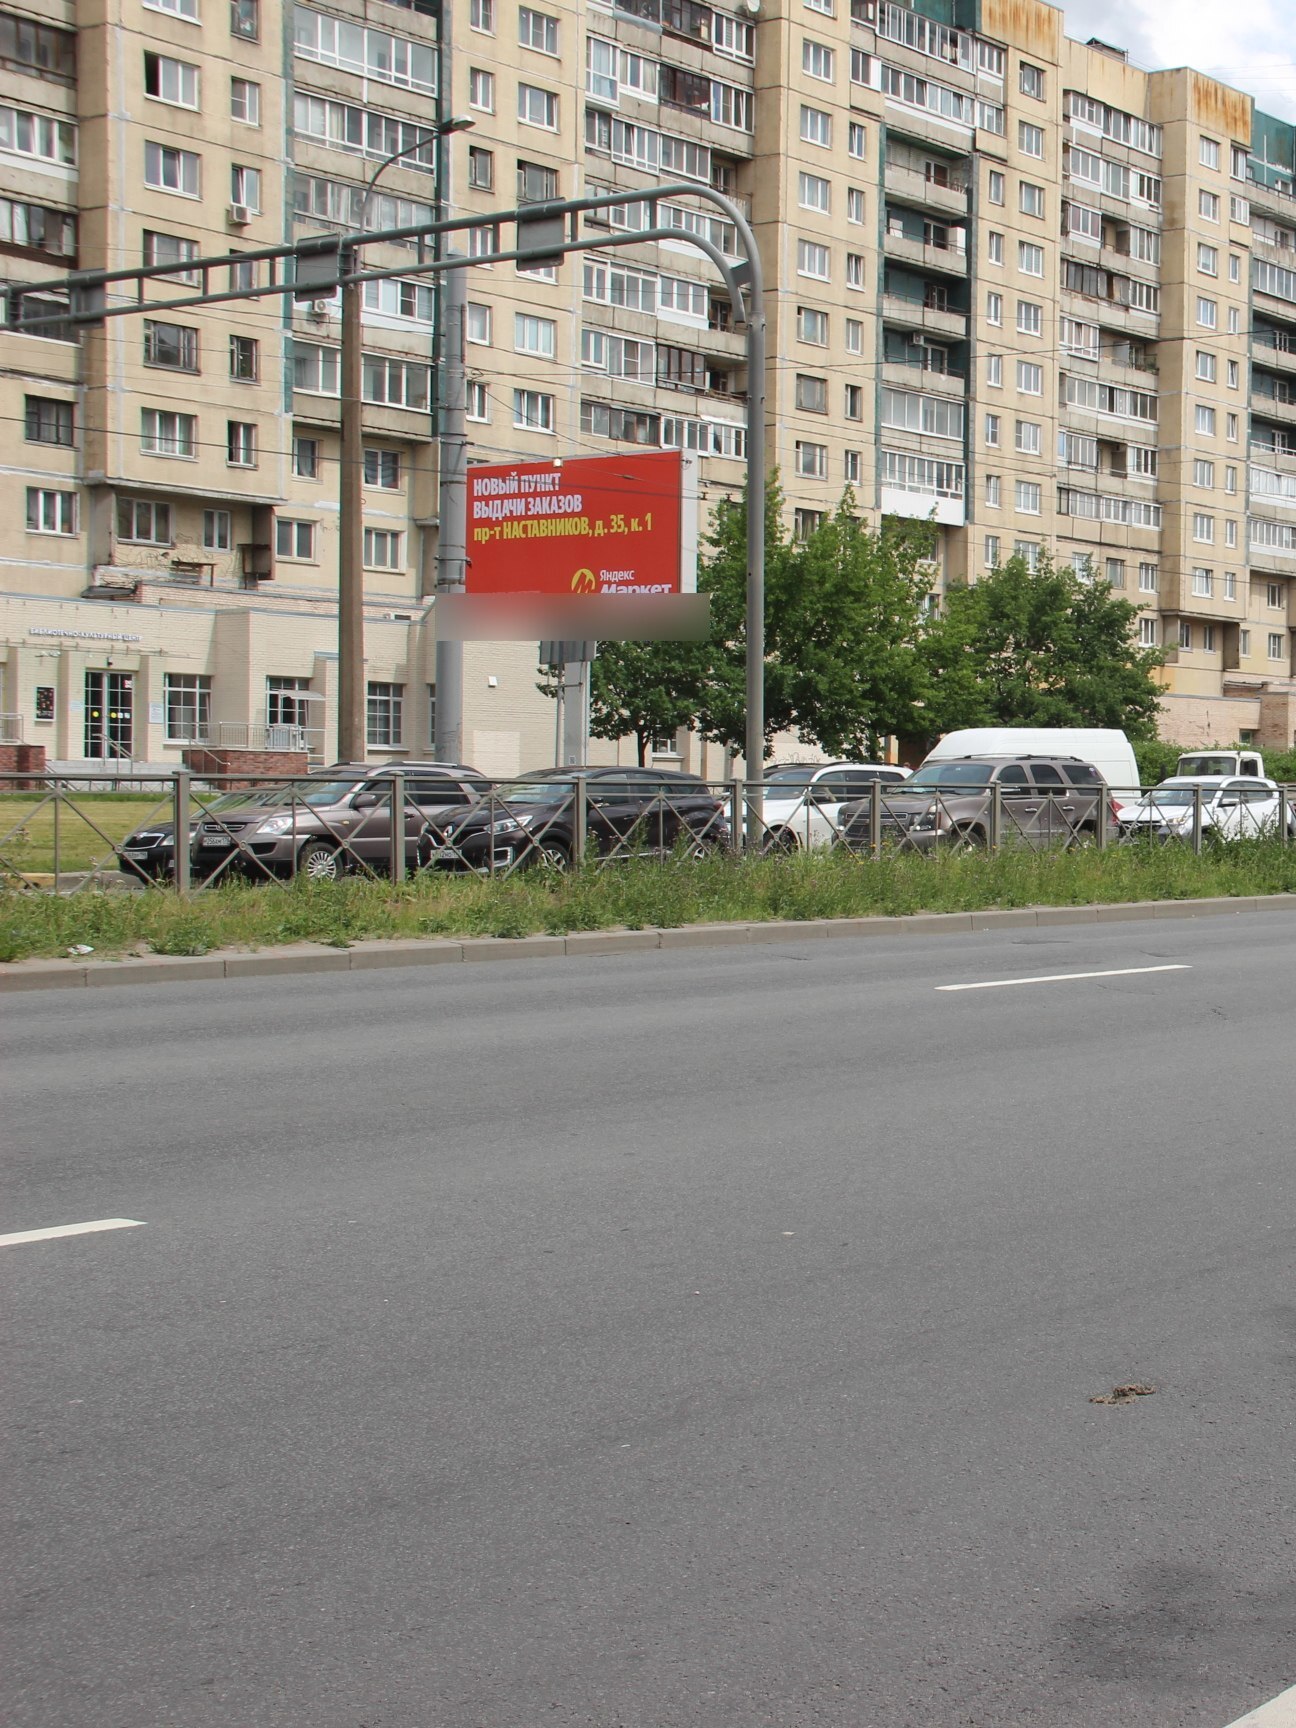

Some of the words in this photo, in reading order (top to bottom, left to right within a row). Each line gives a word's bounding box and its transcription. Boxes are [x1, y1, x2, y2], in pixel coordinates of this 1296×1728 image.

[473, 472, 518, 496] НОВЫЙ
[521, 472, 561, 493] ПУНКТ
[473, 498, 526, 521] ВЫДАЧИ
[527, 494, 582, 516] ЗАКАЗОВ
[473, 526, 501, 544] пр-т
[503, 516, 592, 540] НАСТАВНИКОВ,
[594, 520, 608, 537] д.
[610, 514, 628, 535] 35,
[631, 517, 643, 532] к.
[645, 512, 652, 531] 1
[600, 569, 635, 582] Яндекс
